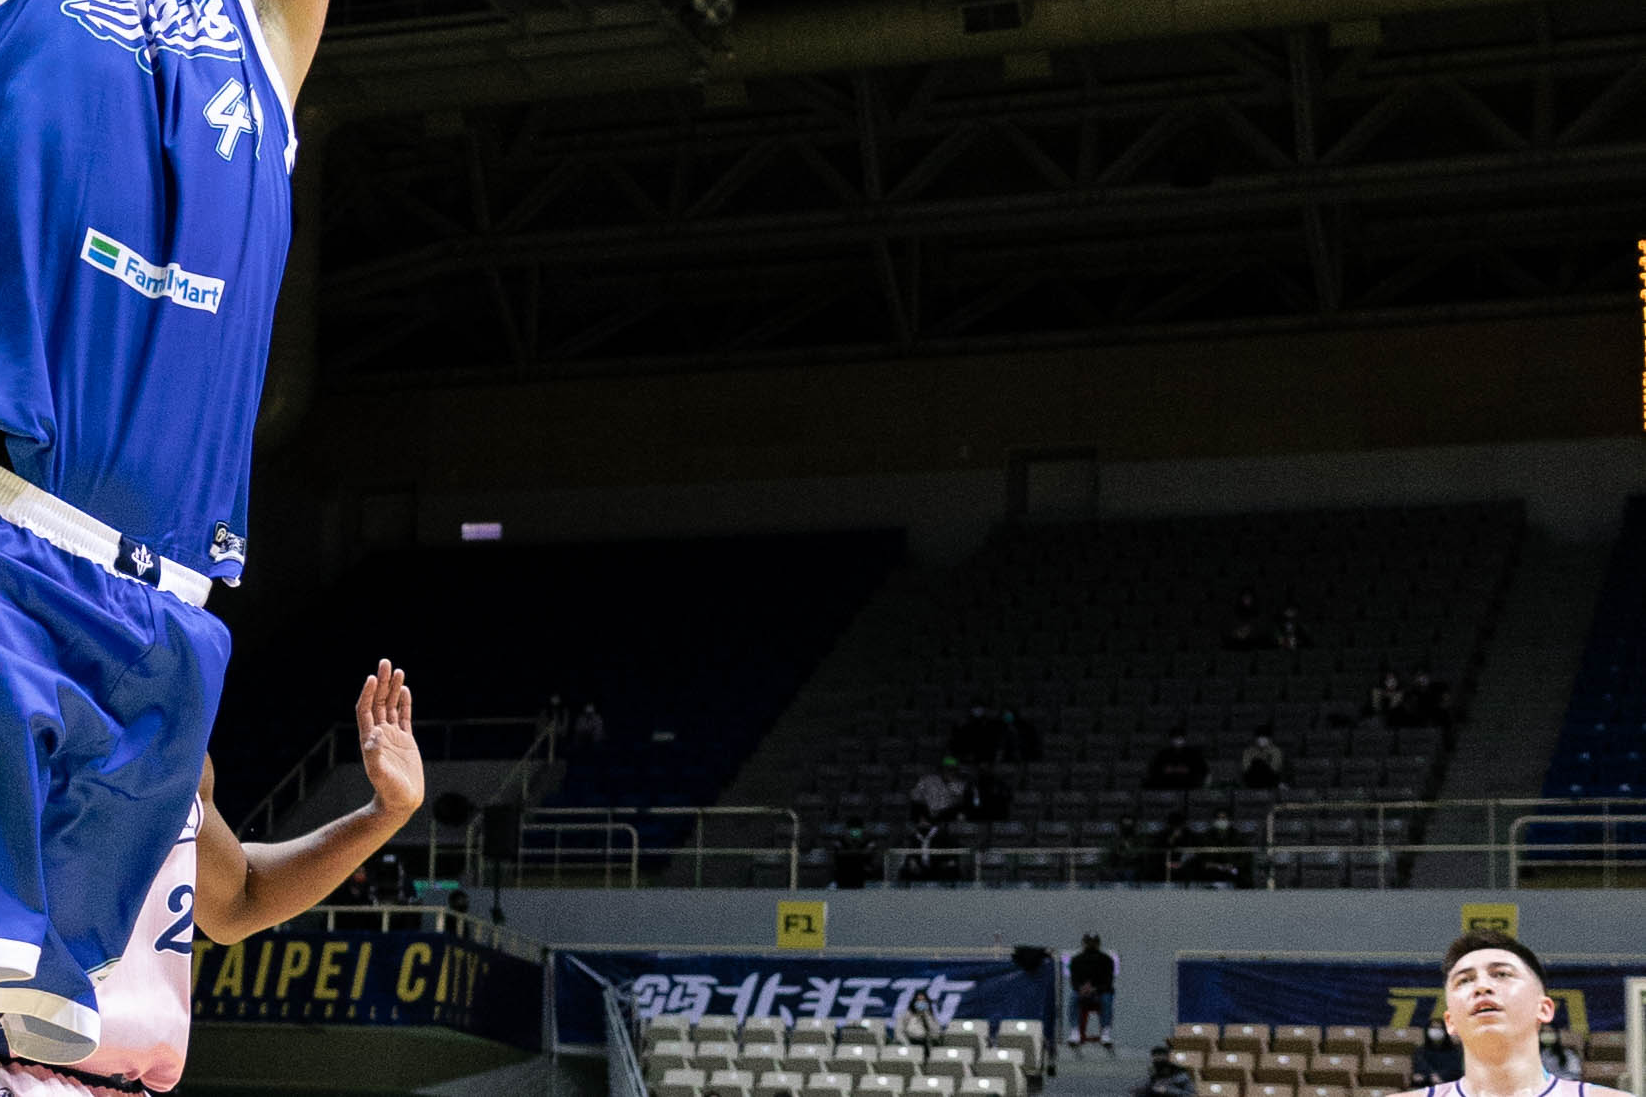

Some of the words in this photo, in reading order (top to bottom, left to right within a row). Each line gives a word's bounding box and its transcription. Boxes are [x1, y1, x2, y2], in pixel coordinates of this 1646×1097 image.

[124, 259, 220, 305] FamlMart
[784, 913, 817, 934] F1
[192, 940, 374, 999] TAIPEI
